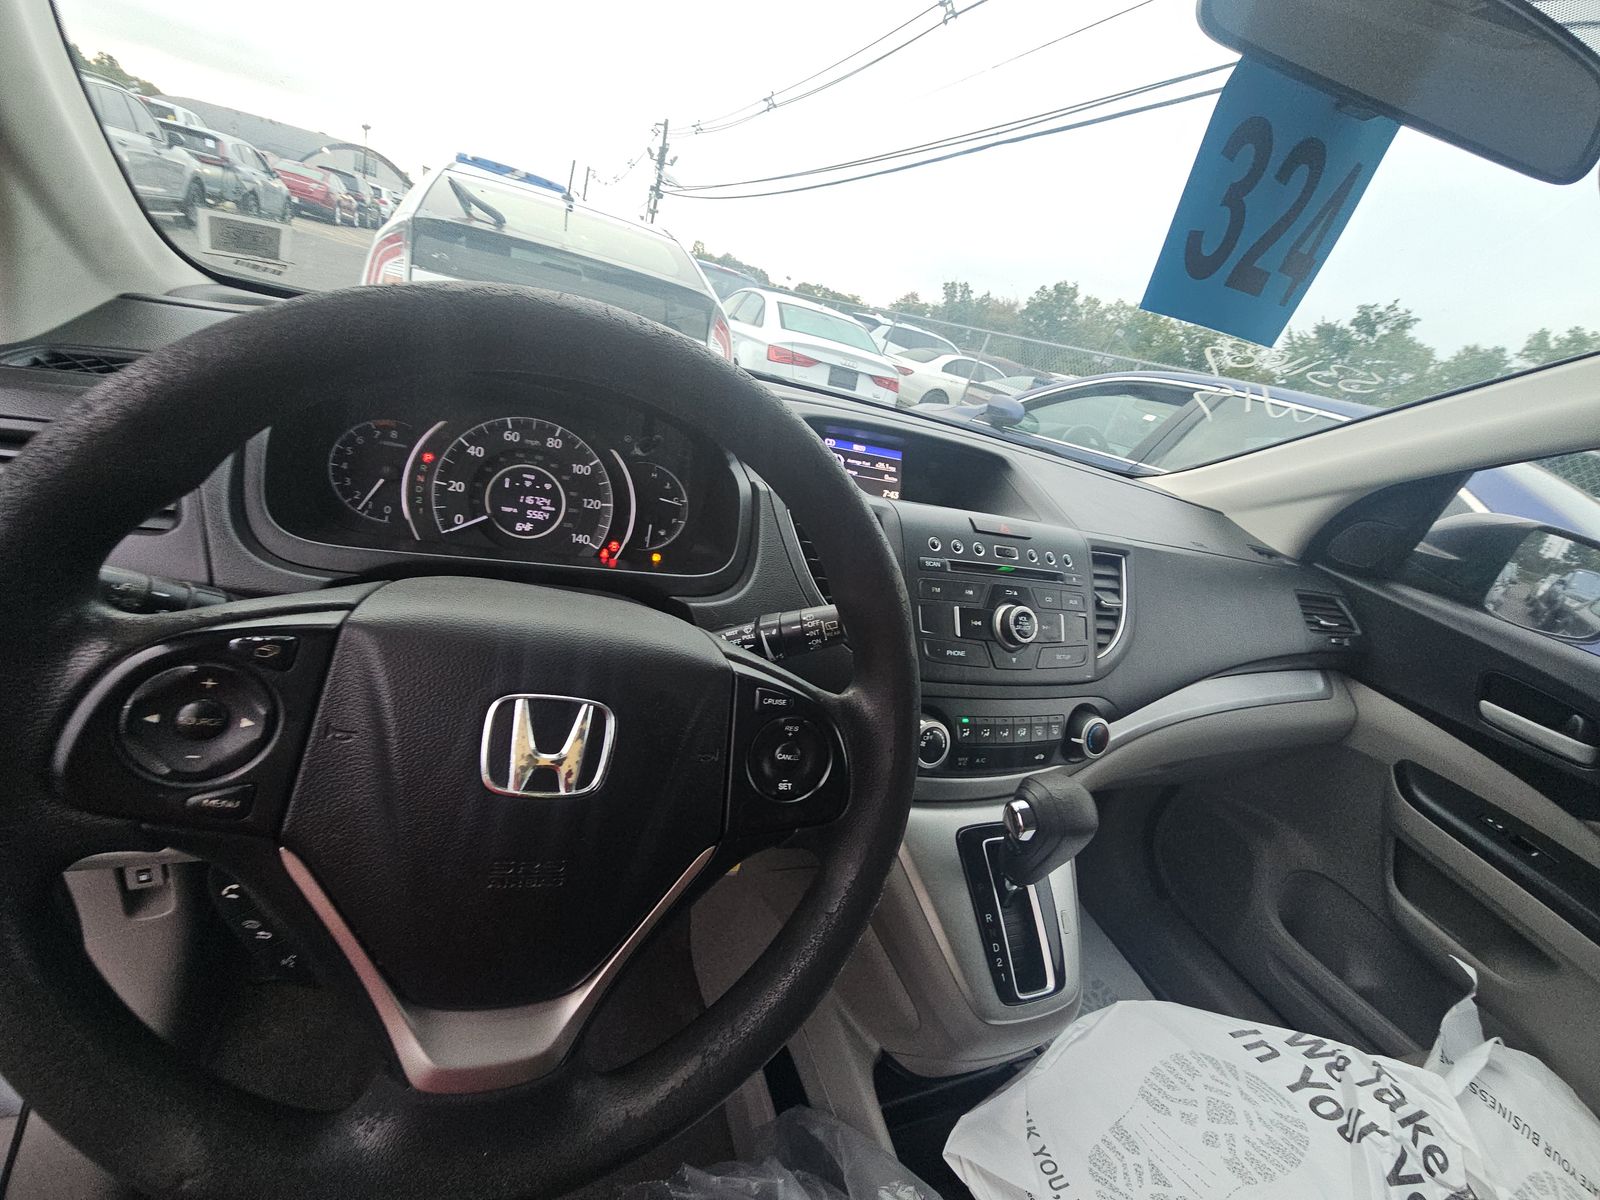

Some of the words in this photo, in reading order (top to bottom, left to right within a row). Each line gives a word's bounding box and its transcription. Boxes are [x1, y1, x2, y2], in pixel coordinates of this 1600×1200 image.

[1184, 115, 1364, 308] 324
[503, 431, 521, 443] 60
[546, 437, 563, 449] 80
[466, 445, 485, 458] 40
[571, 463, 592, 477] 100
[344, 477, 352, 486] 3
[447, 480, 466, 493] 20
[582, 498, 602, 510] 120
[383, 505, 393, 515] 0
[454, 514, 465, 525] 0
[571, 533, 591, 545] 140
[925, 560, 941, 568] SCAN
[806, 620, 821, 628] OFF
[741, 633, 756, 641] PULL
[946, 649, 966, 657] PHONE
[762, 697, 788, 706] CRUISE
[778, 782, 793, 791] SET
[985, 913, 993, 923] R
[992, 943, 1000, 952] D
[996, 958, 1003, 967] 2
[1001, 973, 1006, 982] 1
[1228, 1029, 1281, 1063] In
[1286, 1064, 1390, 1144] Your
[1284, 1031, 1351, 1082] We
[1354, 1060, 1449, 1178] Take
[1468, 1081, 1541, 1147] BUSINESS
[1032, 1144, 1070, 1200] YOU,
